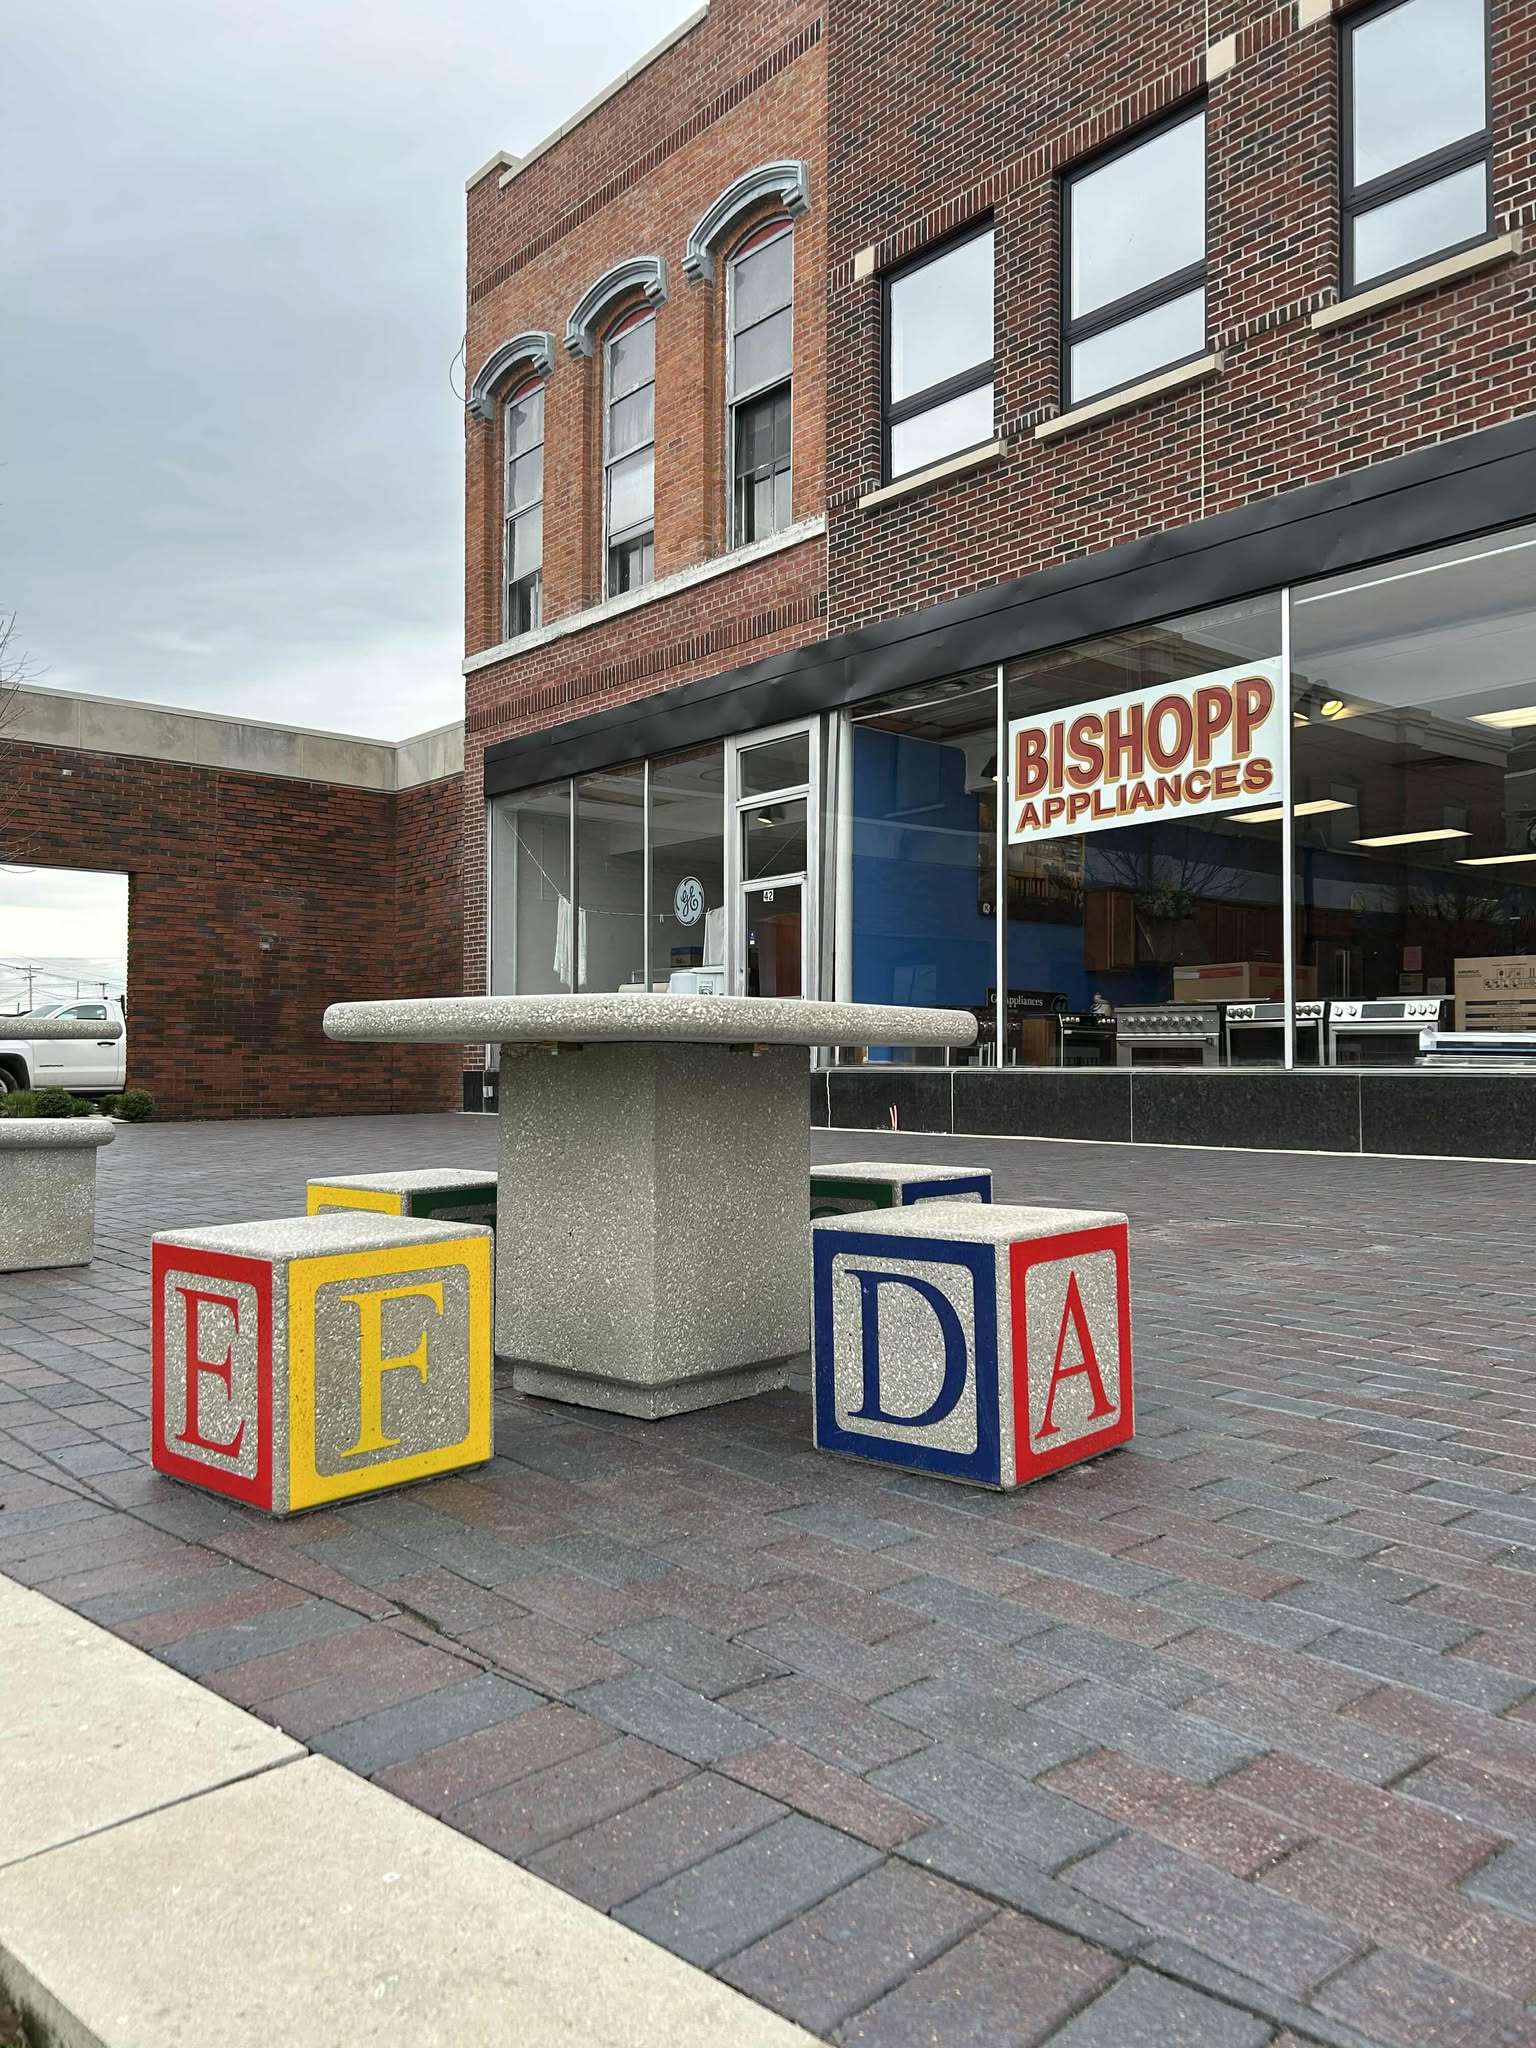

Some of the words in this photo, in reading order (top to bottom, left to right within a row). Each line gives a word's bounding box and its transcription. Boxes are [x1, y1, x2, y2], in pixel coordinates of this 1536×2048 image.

[1015, 675, 1275, 801] BISHOPP
[1015, 757, 1274, 833] APPLIANCES
[763, 891, 773, 900] 42
[175, 1287, 246, 1459] E
[340, 1281, 444, 1458] F
[845, 1269, 967, 1427] D
[1035, 1270, 1117, 1440] A
